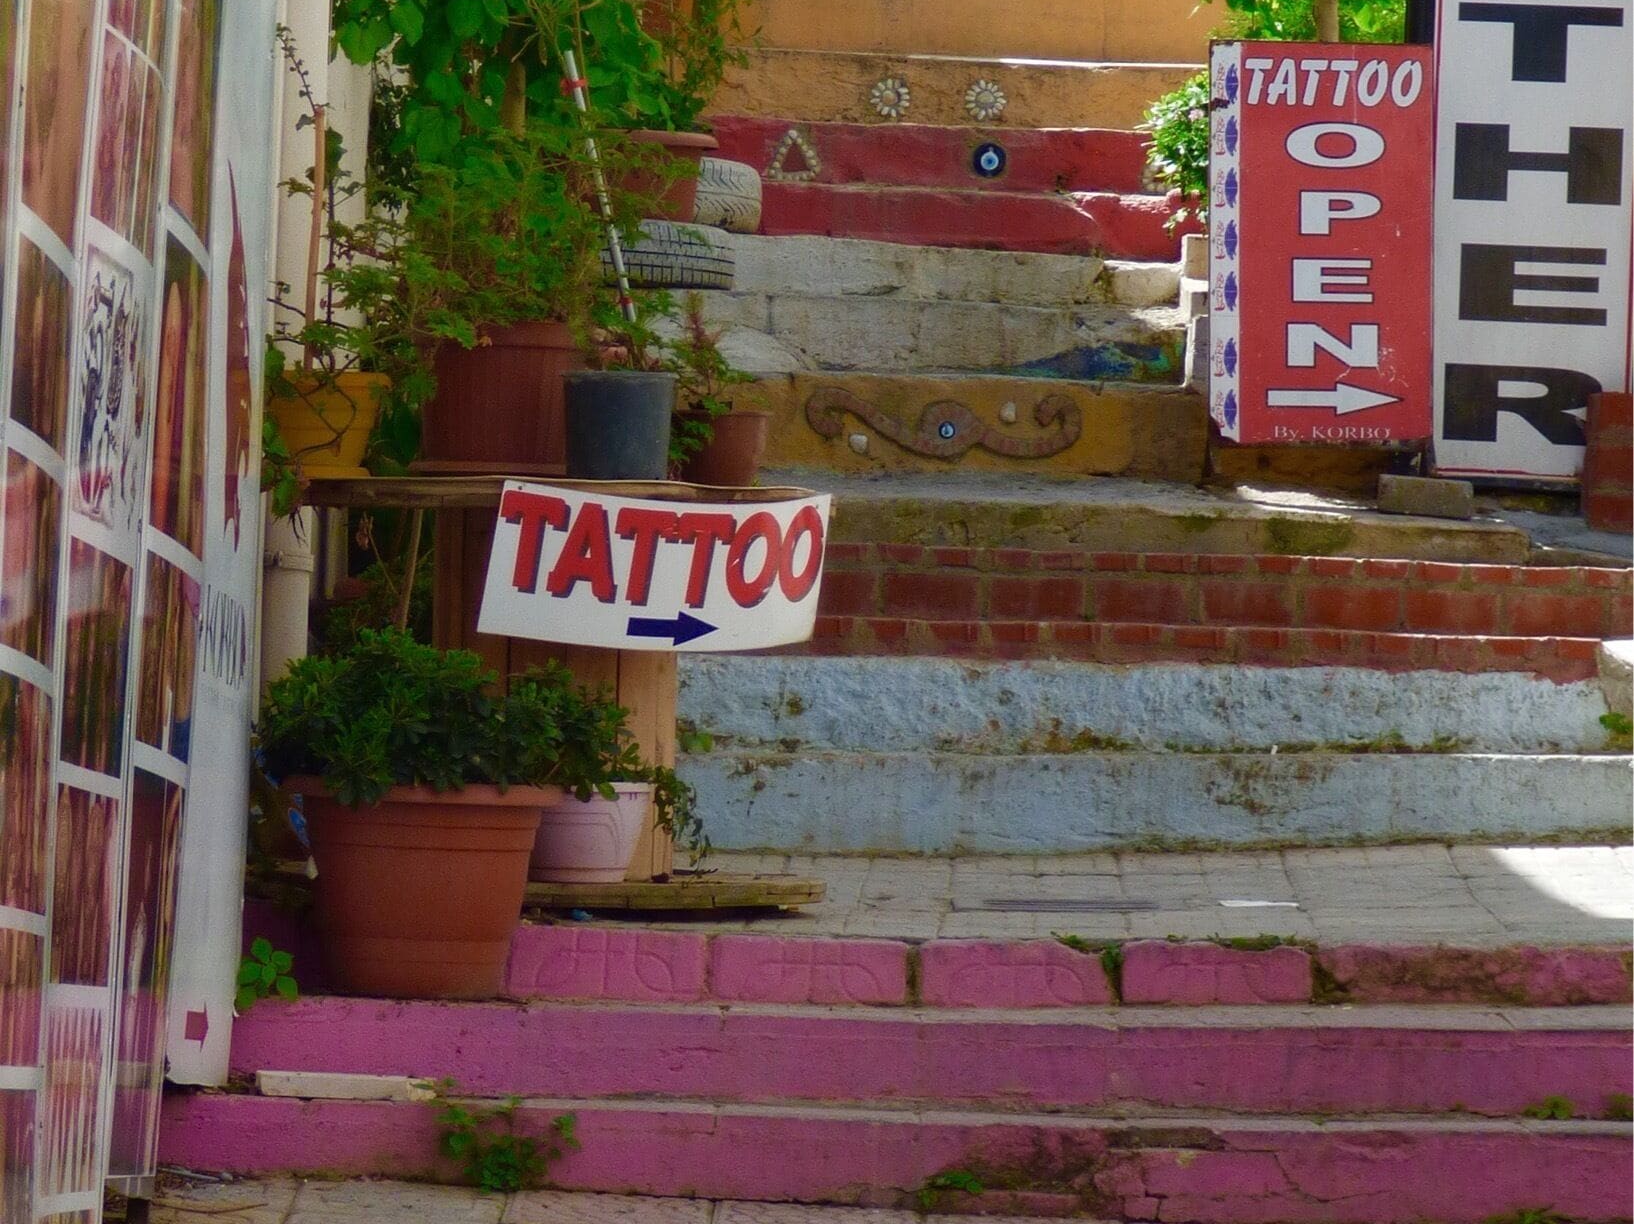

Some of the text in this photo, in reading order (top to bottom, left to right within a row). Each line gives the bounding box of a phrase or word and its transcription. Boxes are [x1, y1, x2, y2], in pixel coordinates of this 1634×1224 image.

[1244, 57, 1423, 108] TATTOO
[1284, 121, 1386, 369] OPEN
[1312, 426, 1391, 440] KORBO
[501, 489, 824, 609] TATTOO
